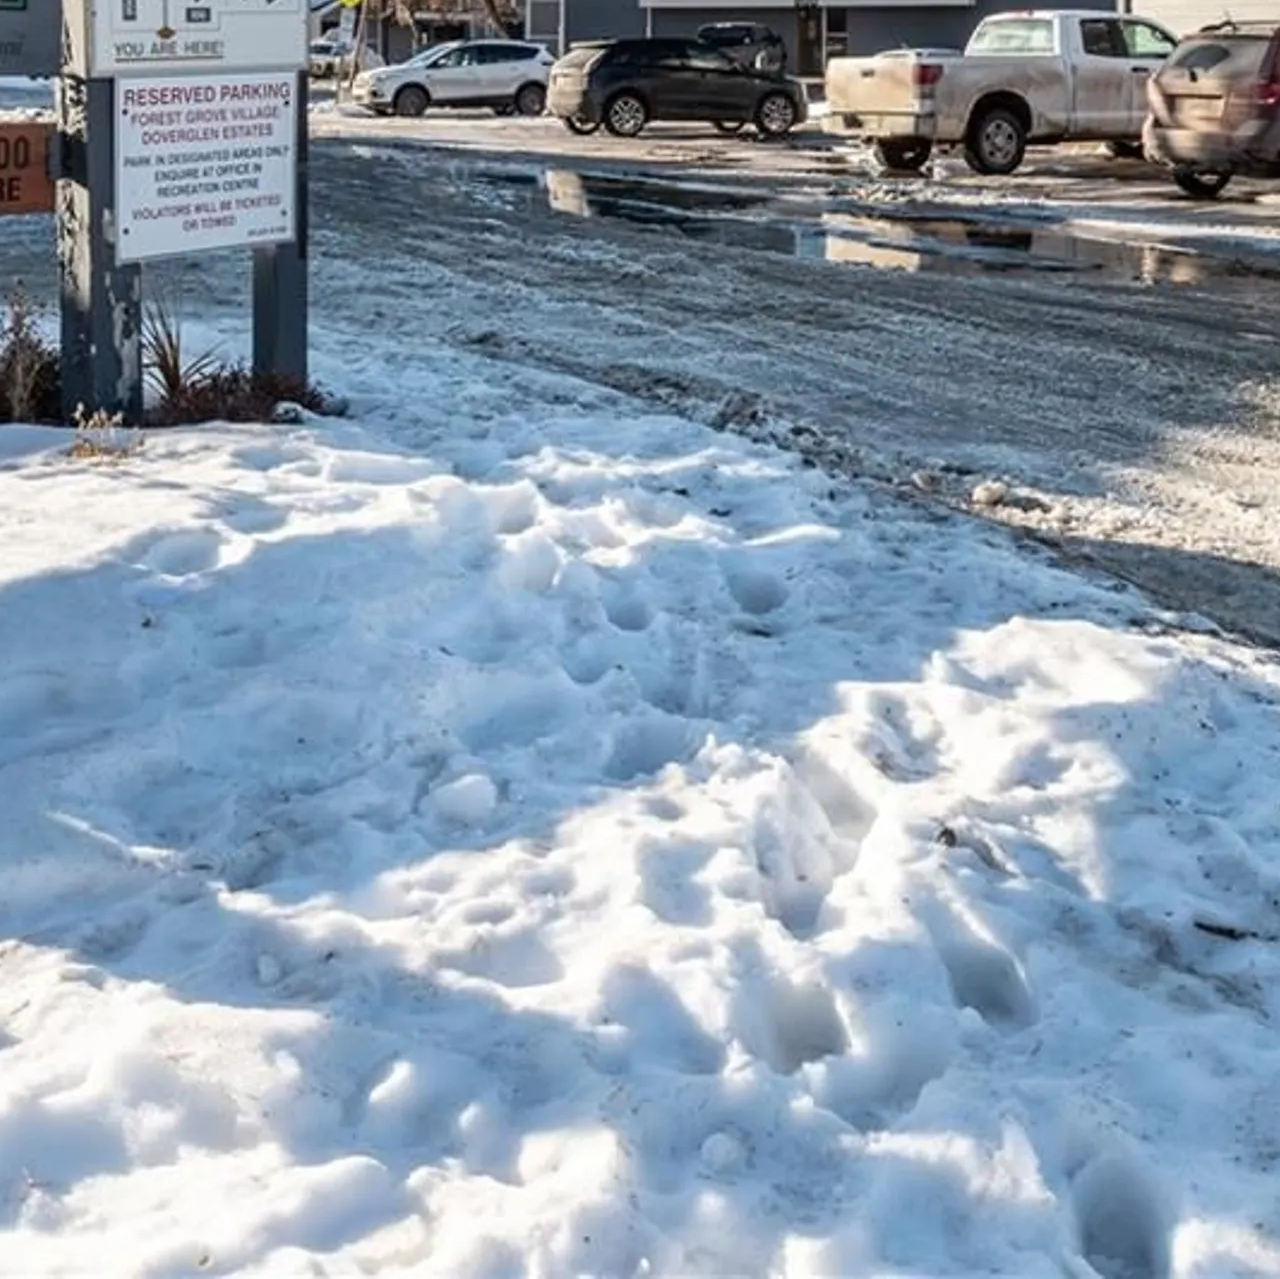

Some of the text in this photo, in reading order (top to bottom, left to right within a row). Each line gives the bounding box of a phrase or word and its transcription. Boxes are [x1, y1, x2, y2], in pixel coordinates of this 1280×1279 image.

[113, 41, 145, 56] YOU
[150, 41, 178, 55] ARE
[123, 81, 291, 106] RESERVED PARKING
[131, 105, 280, 127] FOREST GROVE VILLAGE
[222, 123, 273, 141] ESTATES
[123, 145, 290, 168] PARK IN DESIGNATED AREAS ONLY
[203, 166, 215, 177] AT
[216, 163, 251, 177] OFFICE
[253, 162, 263, 174] IN
[157, 178, 259, 198] RECREATION CENTRE
[132, 195, 282, 220] VIOLATORS WILL BE TICKETED
[182, 215, 238, 232] OR TOWED
